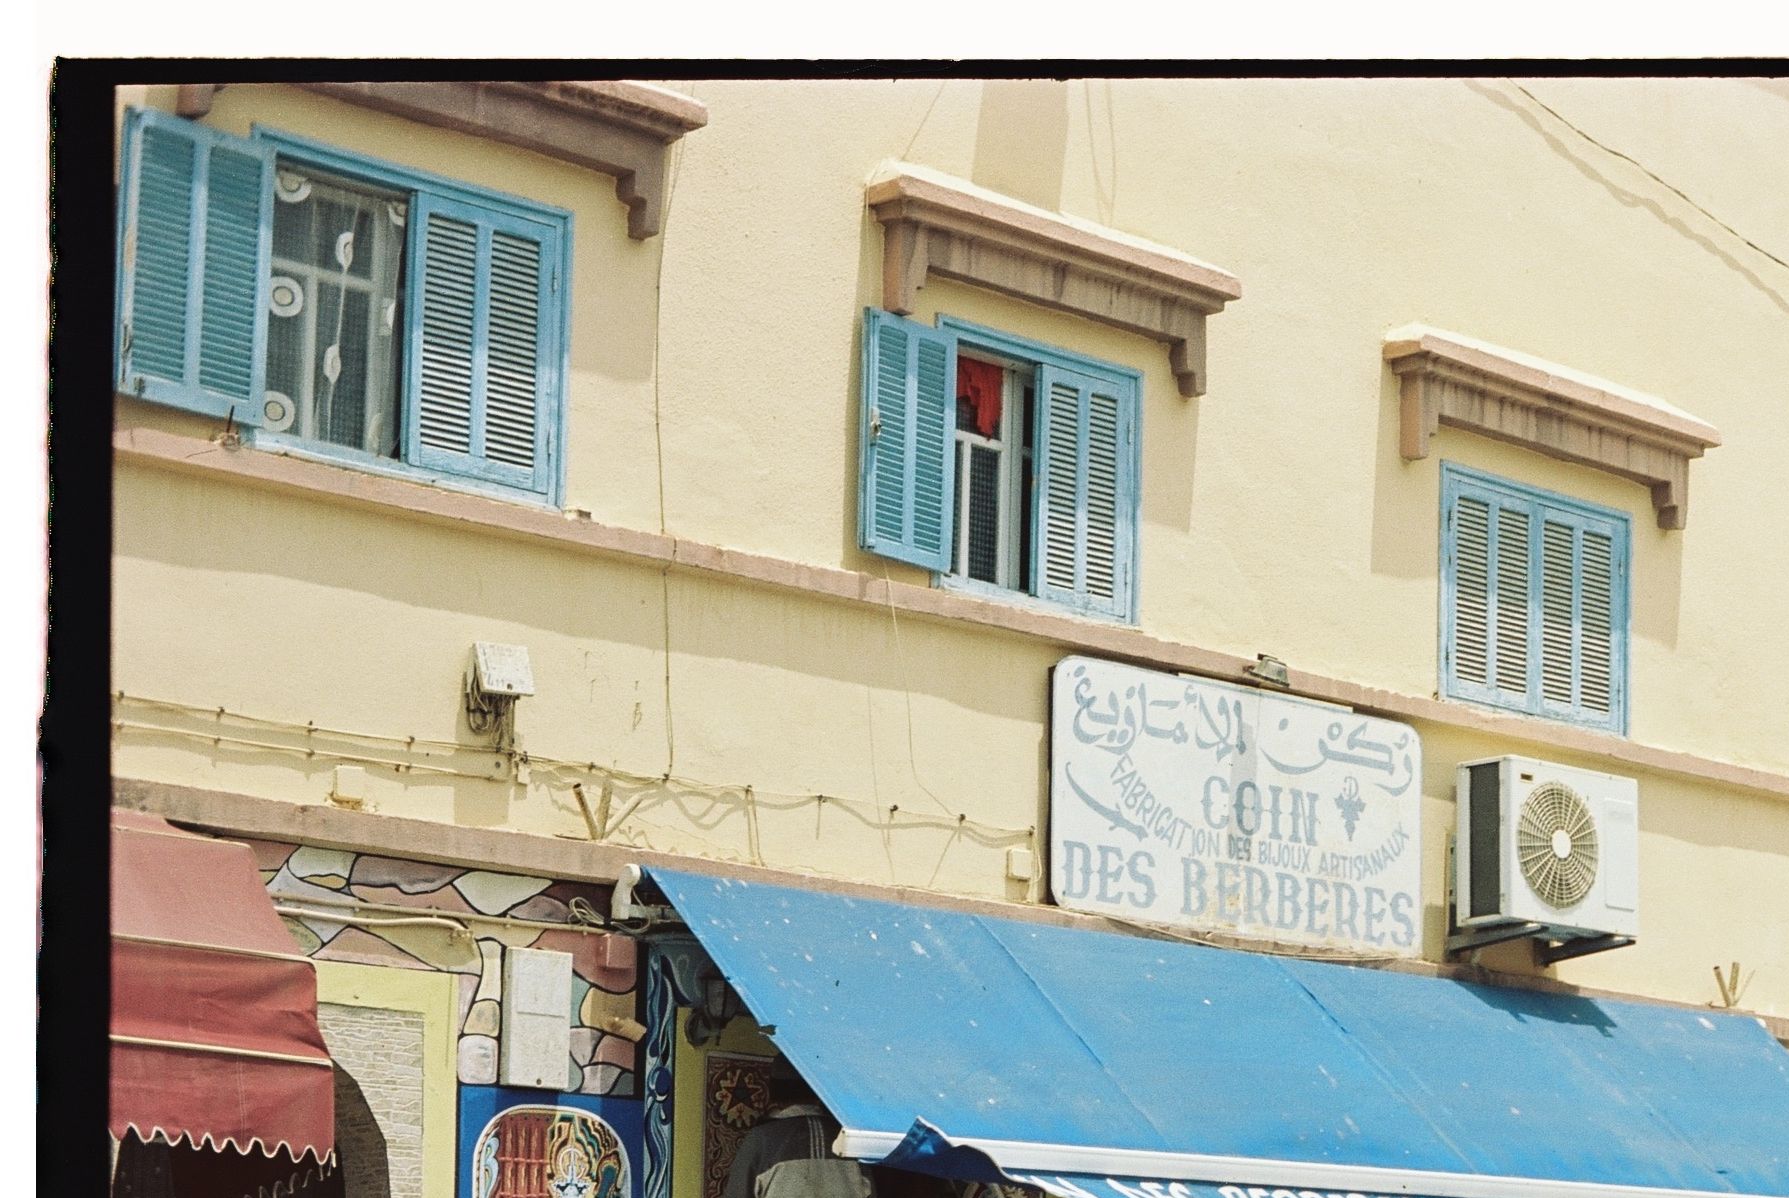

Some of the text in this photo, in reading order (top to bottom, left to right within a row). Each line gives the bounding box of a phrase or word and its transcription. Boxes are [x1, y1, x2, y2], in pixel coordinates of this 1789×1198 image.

[1109, 753, 1411, 881] FABRICATION DES BIJOUX ARTISANAUX
[1201, 775, 1320, 847] COIN
[1062, 840, 1416, 948] DES BERBERES
